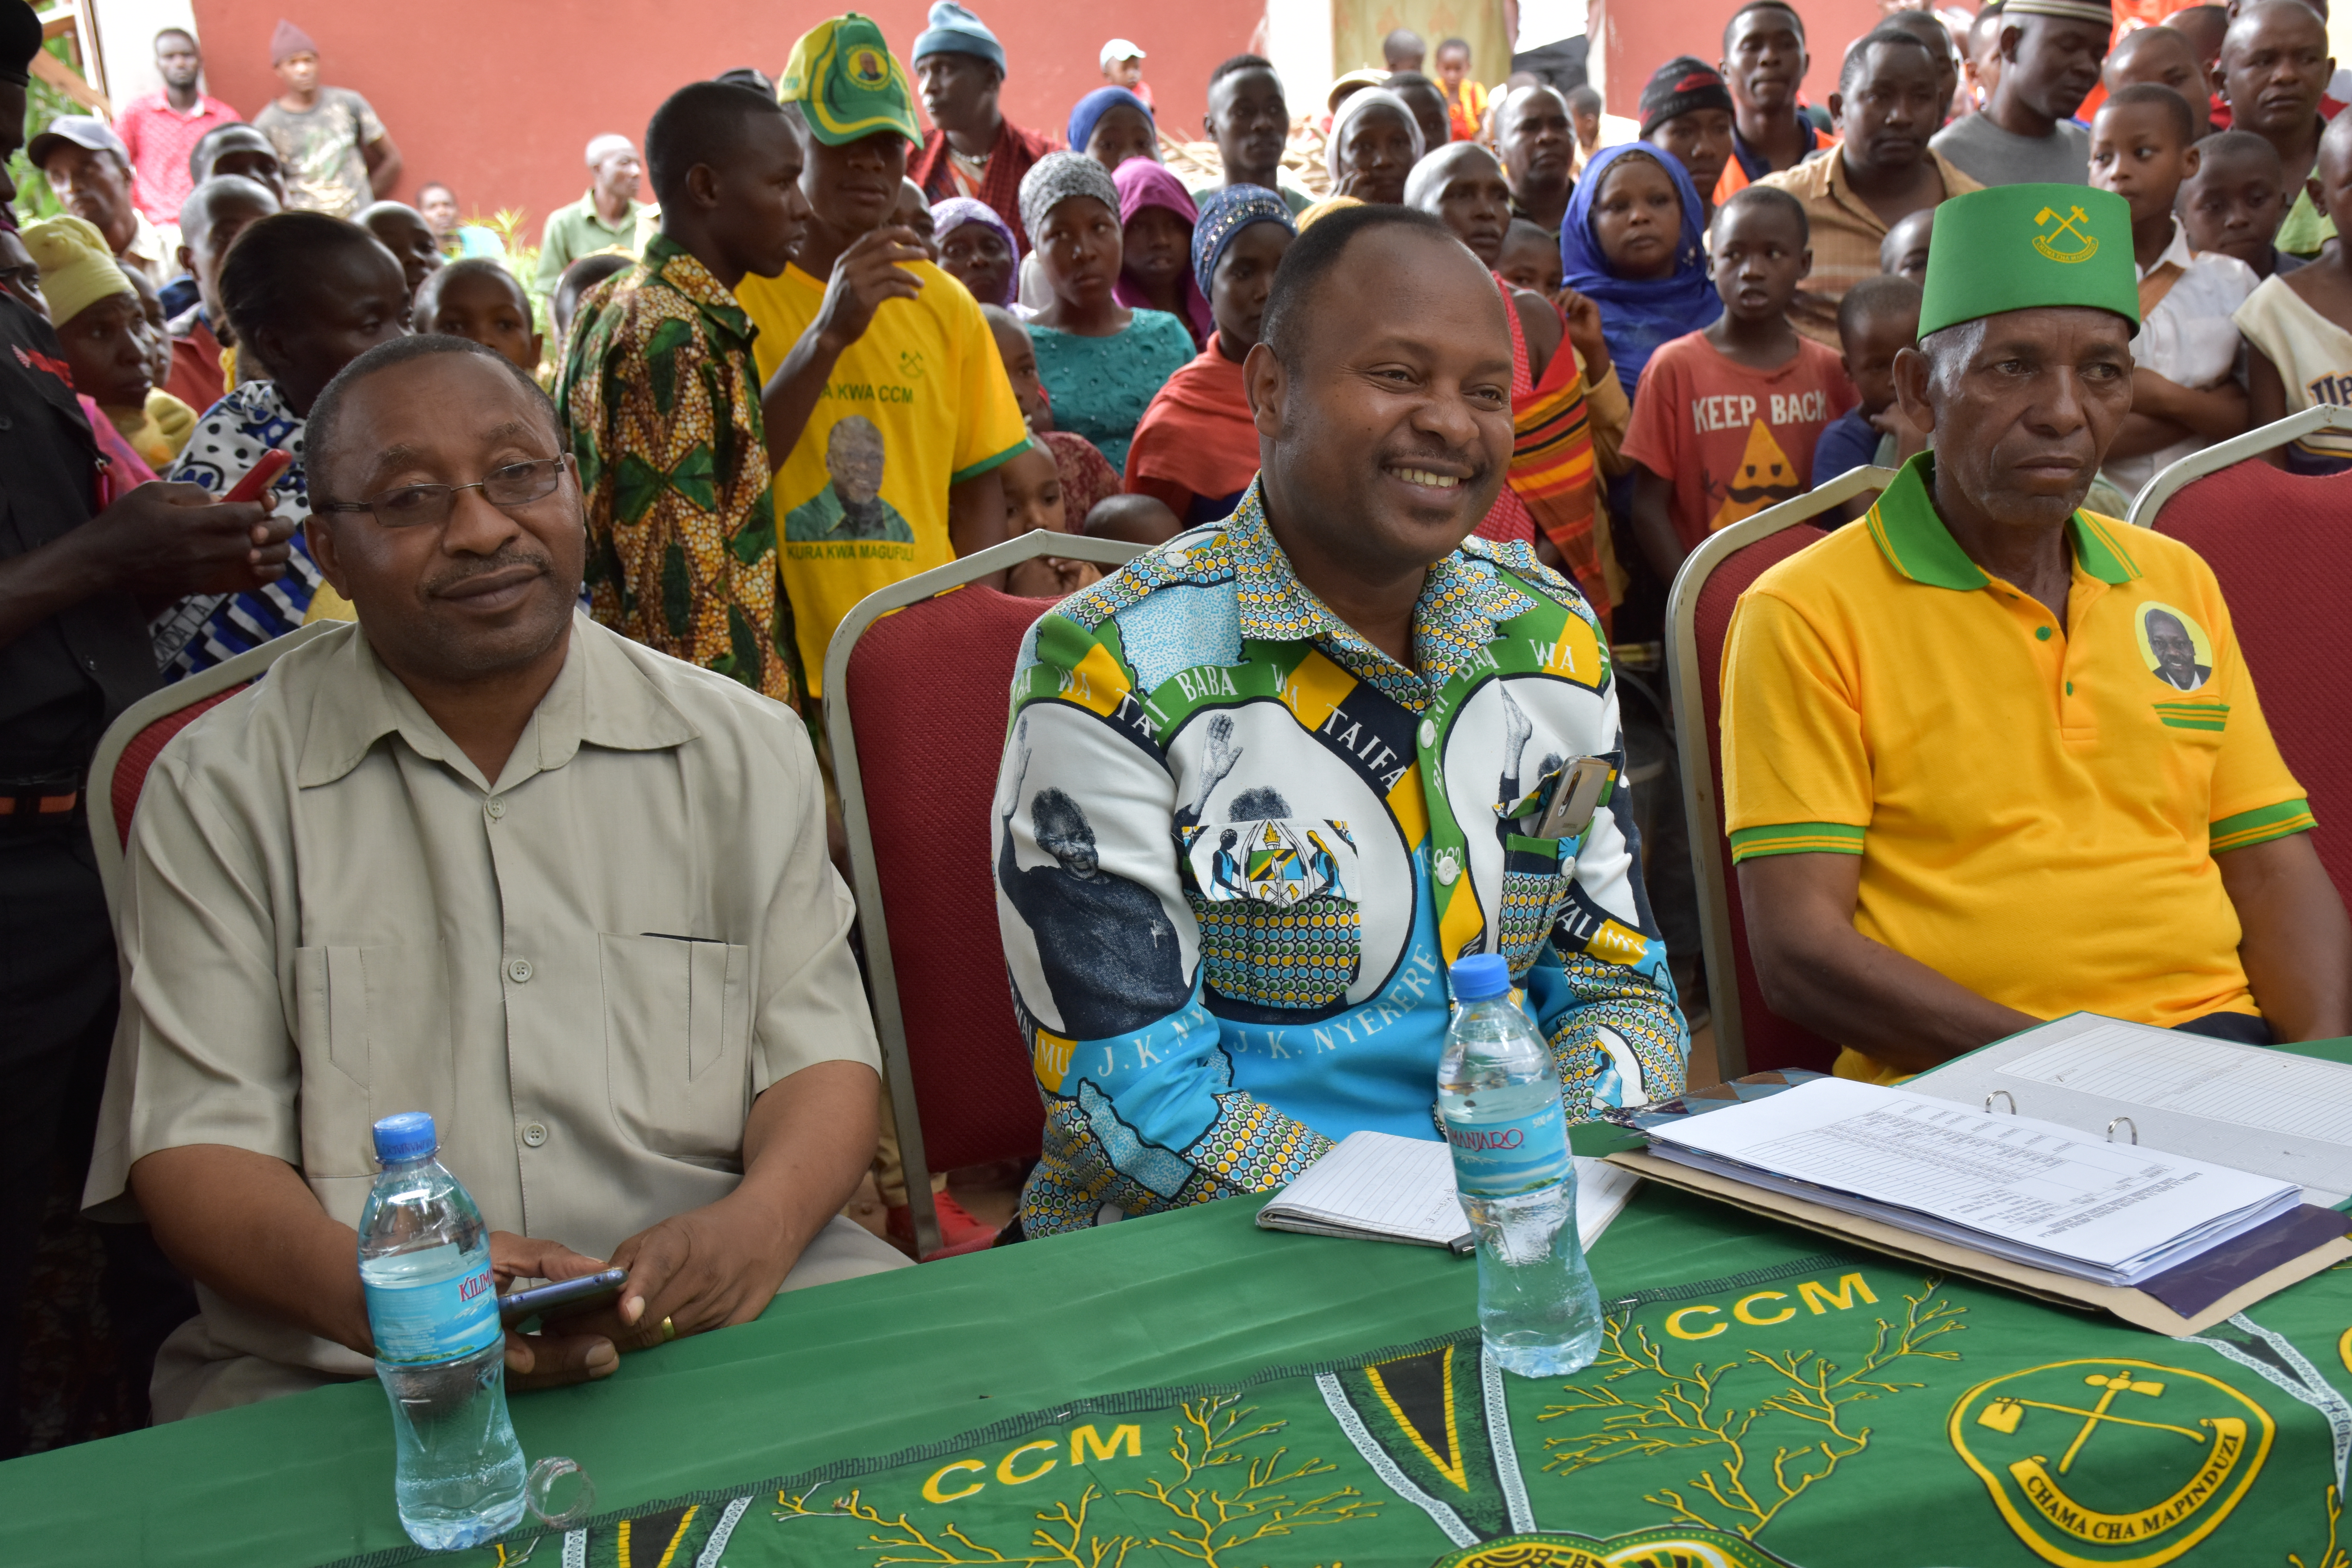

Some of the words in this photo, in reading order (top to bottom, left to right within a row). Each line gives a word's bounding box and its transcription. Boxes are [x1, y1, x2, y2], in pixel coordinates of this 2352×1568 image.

[837, 384, 875, 402] KWA
[878, 385, 914, 404] CCM
[1692, 395, 1757, 434] KEEP
[1770, 390, 1827, 425] BACK
[787, 545, 824, 561] KURA
[826, 544, 857, 560] KWA
[1053, 666, 1091, 701] WA
[1529, 639, 1576, 673] WA
[1174, 666, 1239, 704] BABA
[1271, 663, 1299, 713] WA
[1323, 702, 1408, 793] TAIFA
[1311, 944, 1438, 1055] NYERERE
[1664, 1272, 1880, 1341] CCM
[920, 1422, 1142, 1504] CCM
[2025, 1474, 2088, 1536] CHAMA
[2092, 1520, 2137, 1540] CHA
[2142, 1433, 2240, 1533] MAPINDUZI
